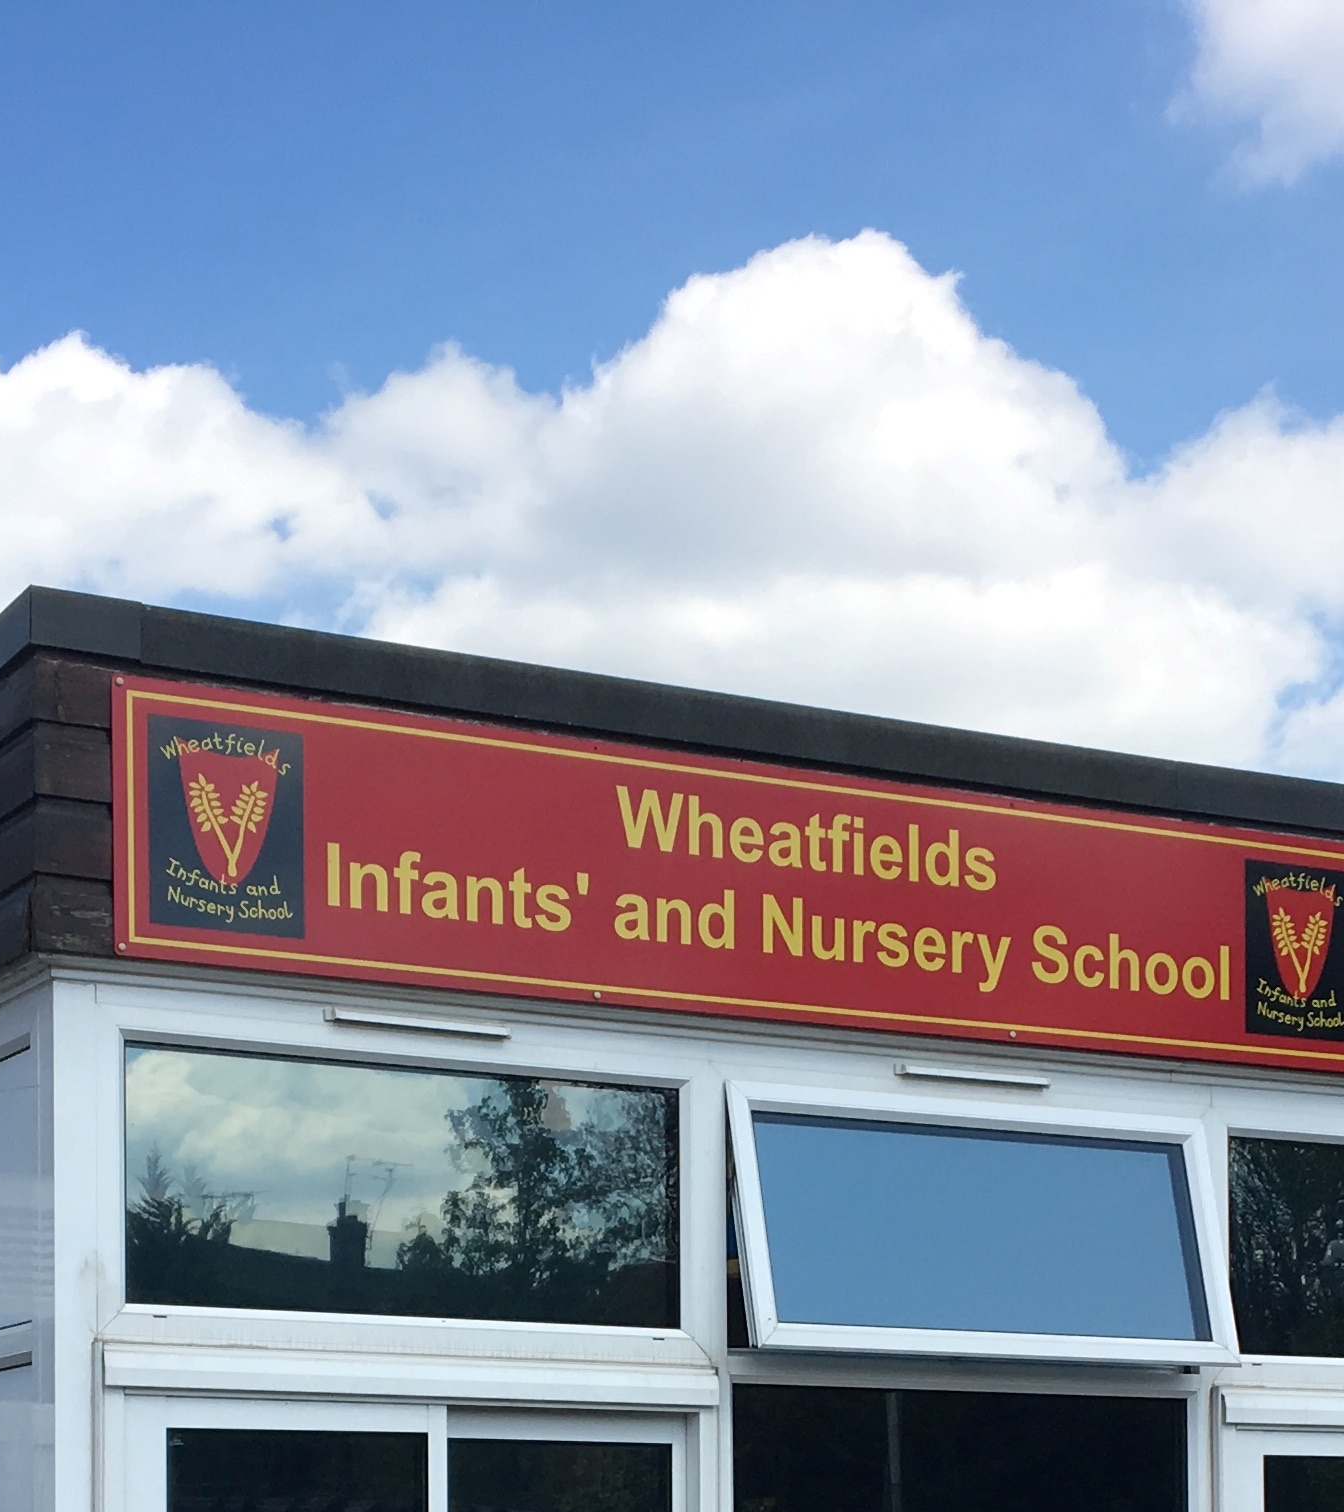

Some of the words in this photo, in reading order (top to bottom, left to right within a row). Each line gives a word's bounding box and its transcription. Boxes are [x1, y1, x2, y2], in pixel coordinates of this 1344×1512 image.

[616, 785, 996, 891] Wheatfields
[165, 857, 238, 895] Infants
[246, 875, 281, 896] and
[167, 886, 235, 923] Nursery
[238, 900, 294, 920] School
[327, 842, 589, 932] Infants'
[613, 889, 735, 950] and
[762, 894, 1011, 992] Nursery
[1031, 925, 1231, 1001] School
[1256, 977, 1306, 1008] Infants
[1312, 990, 1337, 1008] and
[1257, 1001, 1305, 1032] Nursery
